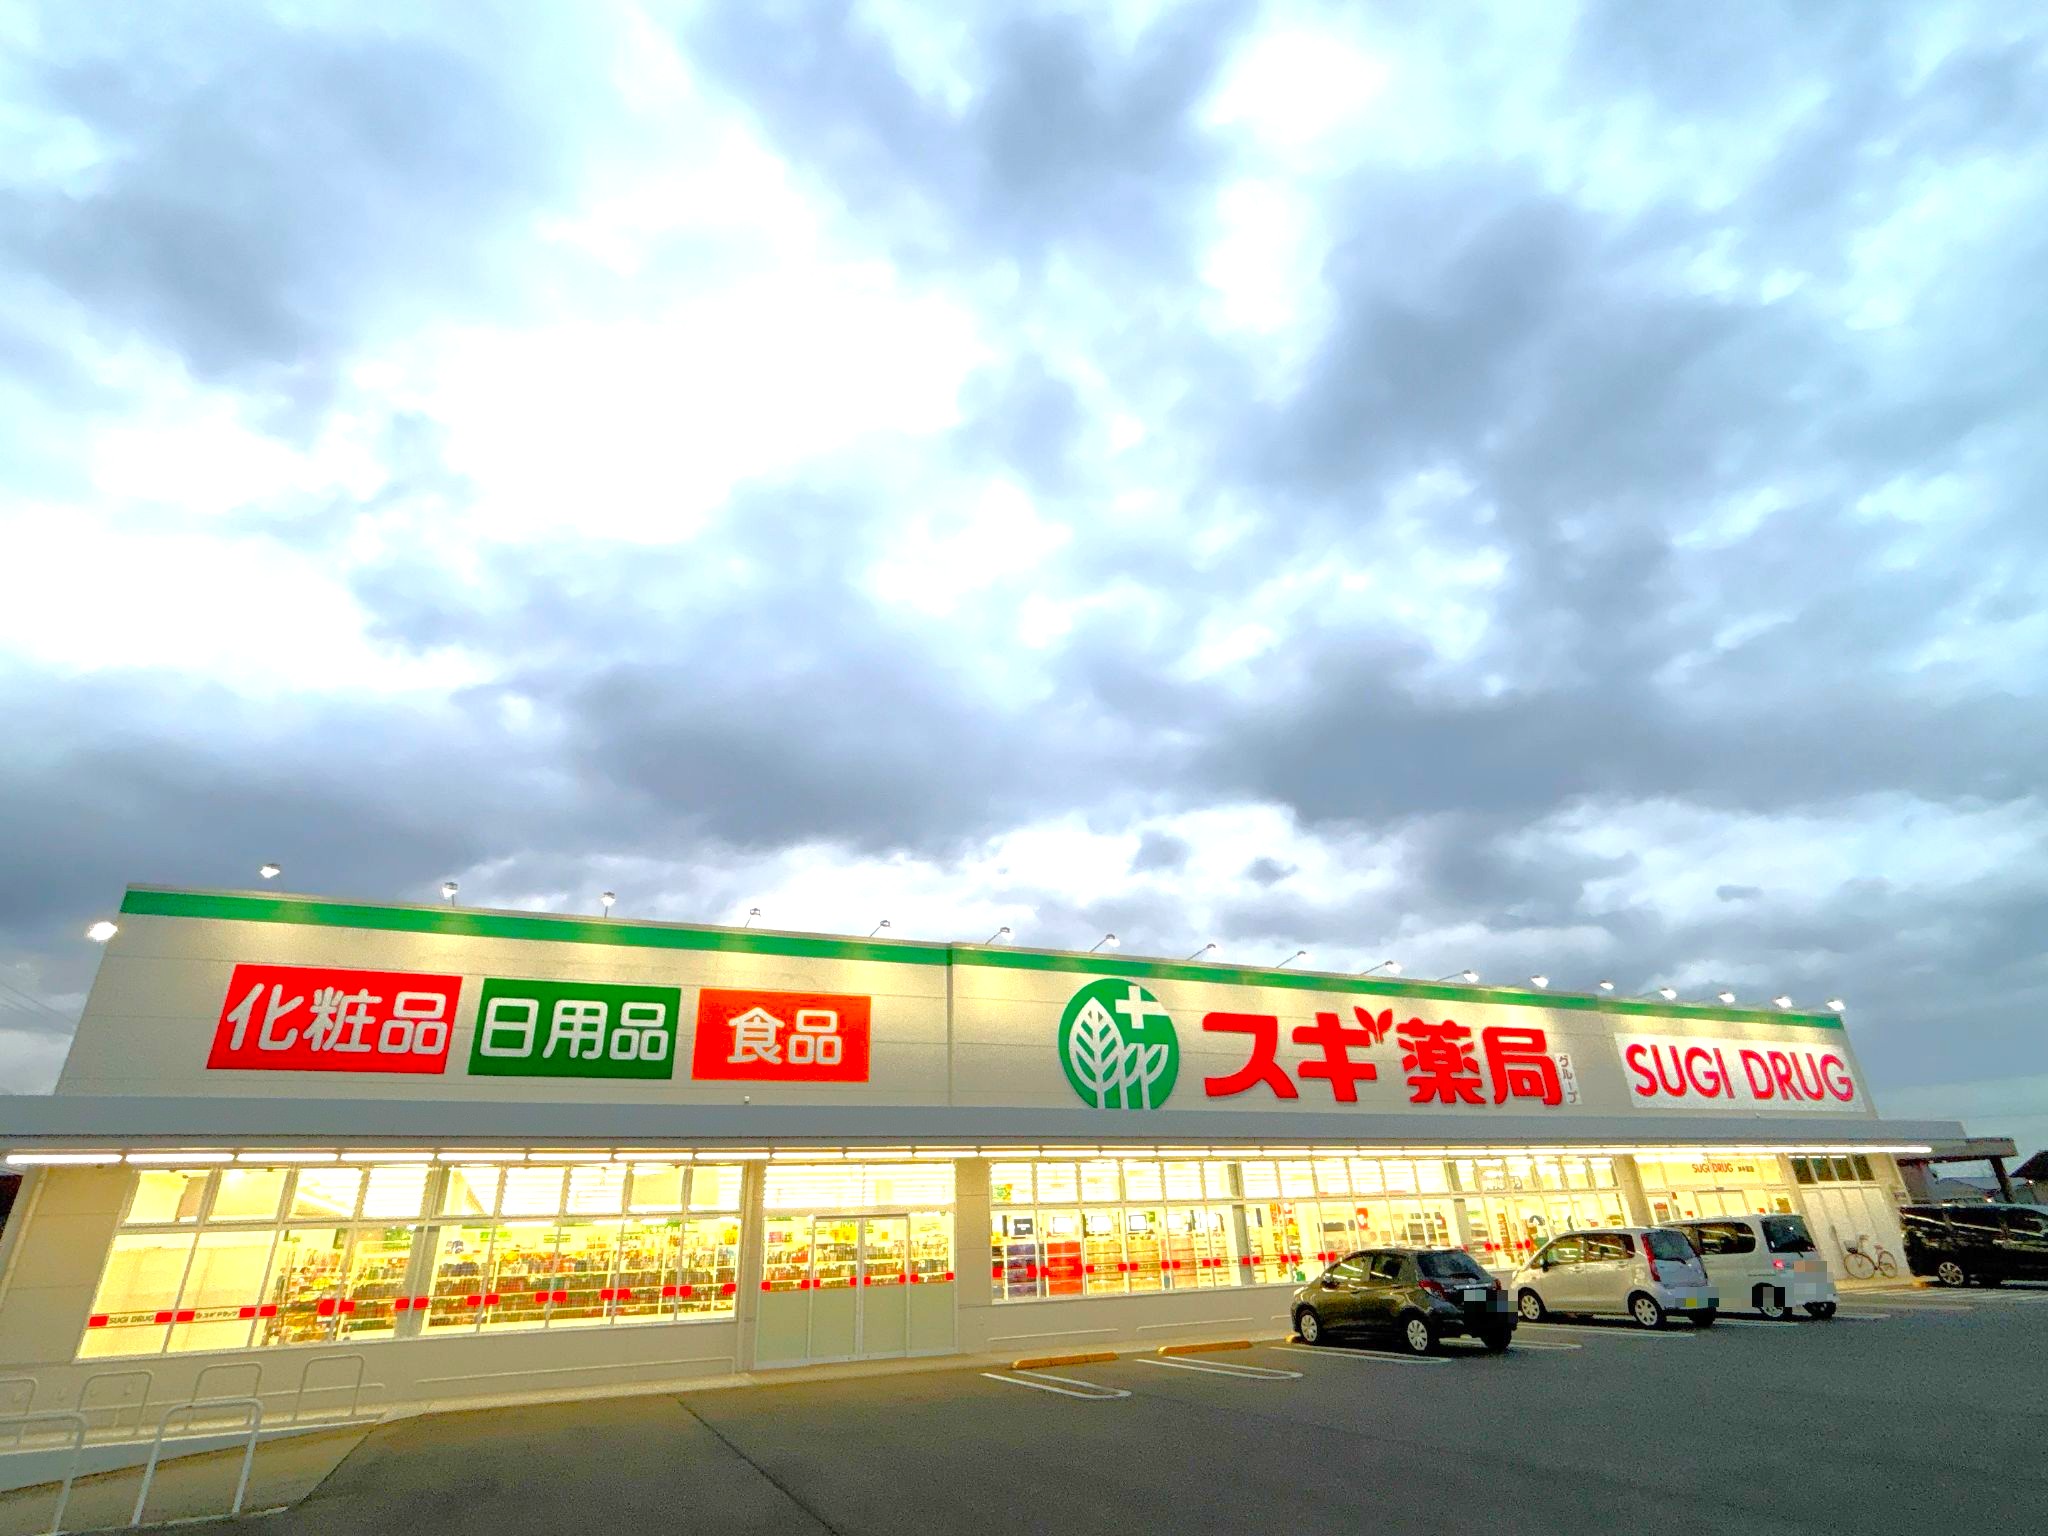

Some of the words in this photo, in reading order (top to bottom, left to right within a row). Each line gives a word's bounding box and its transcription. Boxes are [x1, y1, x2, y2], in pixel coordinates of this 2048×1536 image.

[226, 983, 448, 1055] 化粧品
[479, 997, 669, 1061] 日用品
[727, 1007, 842, 1064] 食品
[1202, 1006, 1563, 1105] スギ薬局
[1559, 1055, 1577, 1103] グループ
[1625, 1043, 1735, 1099] SUGI
[1739, 1049, 1854, 1102] DRUG
[1692, 1163, 1710, 1173] SUGI
[1711, 1163, 1734, 1173] DRUG
